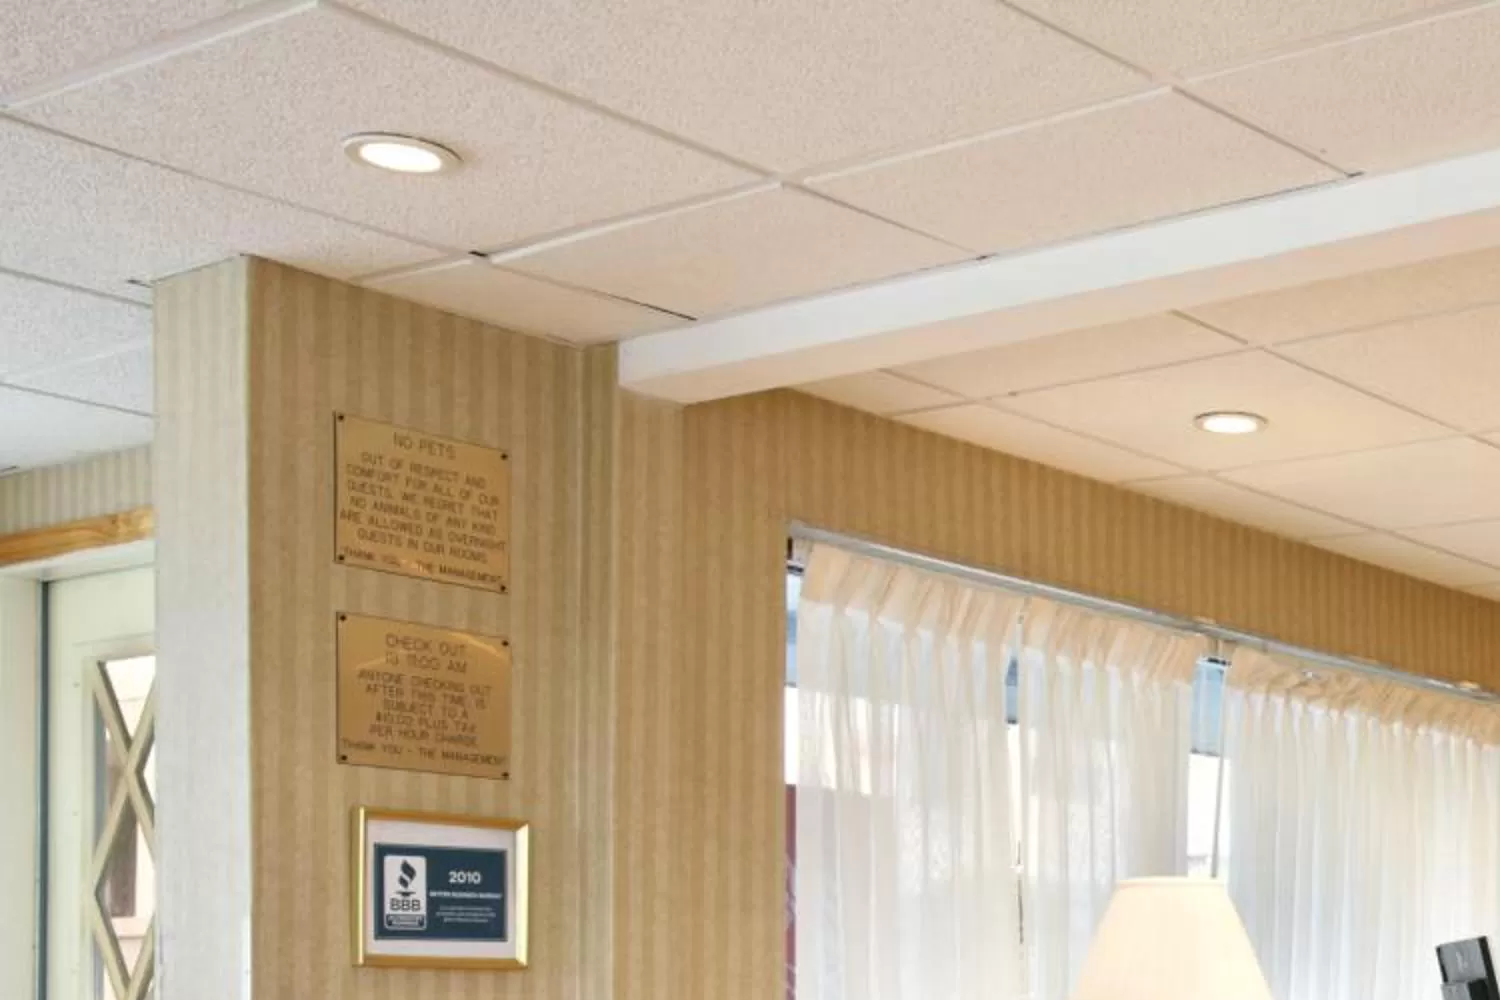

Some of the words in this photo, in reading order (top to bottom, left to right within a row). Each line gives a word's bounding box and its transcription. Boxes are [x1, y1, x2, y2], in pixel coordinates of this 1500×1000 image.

[393, 432, 413, 450] NO
[419, 439, 456, 460] PETS
[386, 633, 432, 651] CHECK
[439, 641, 467, 657] OUT
[448, 870, 482, 884] 2010
[390, 898, 421, 911] BBB
